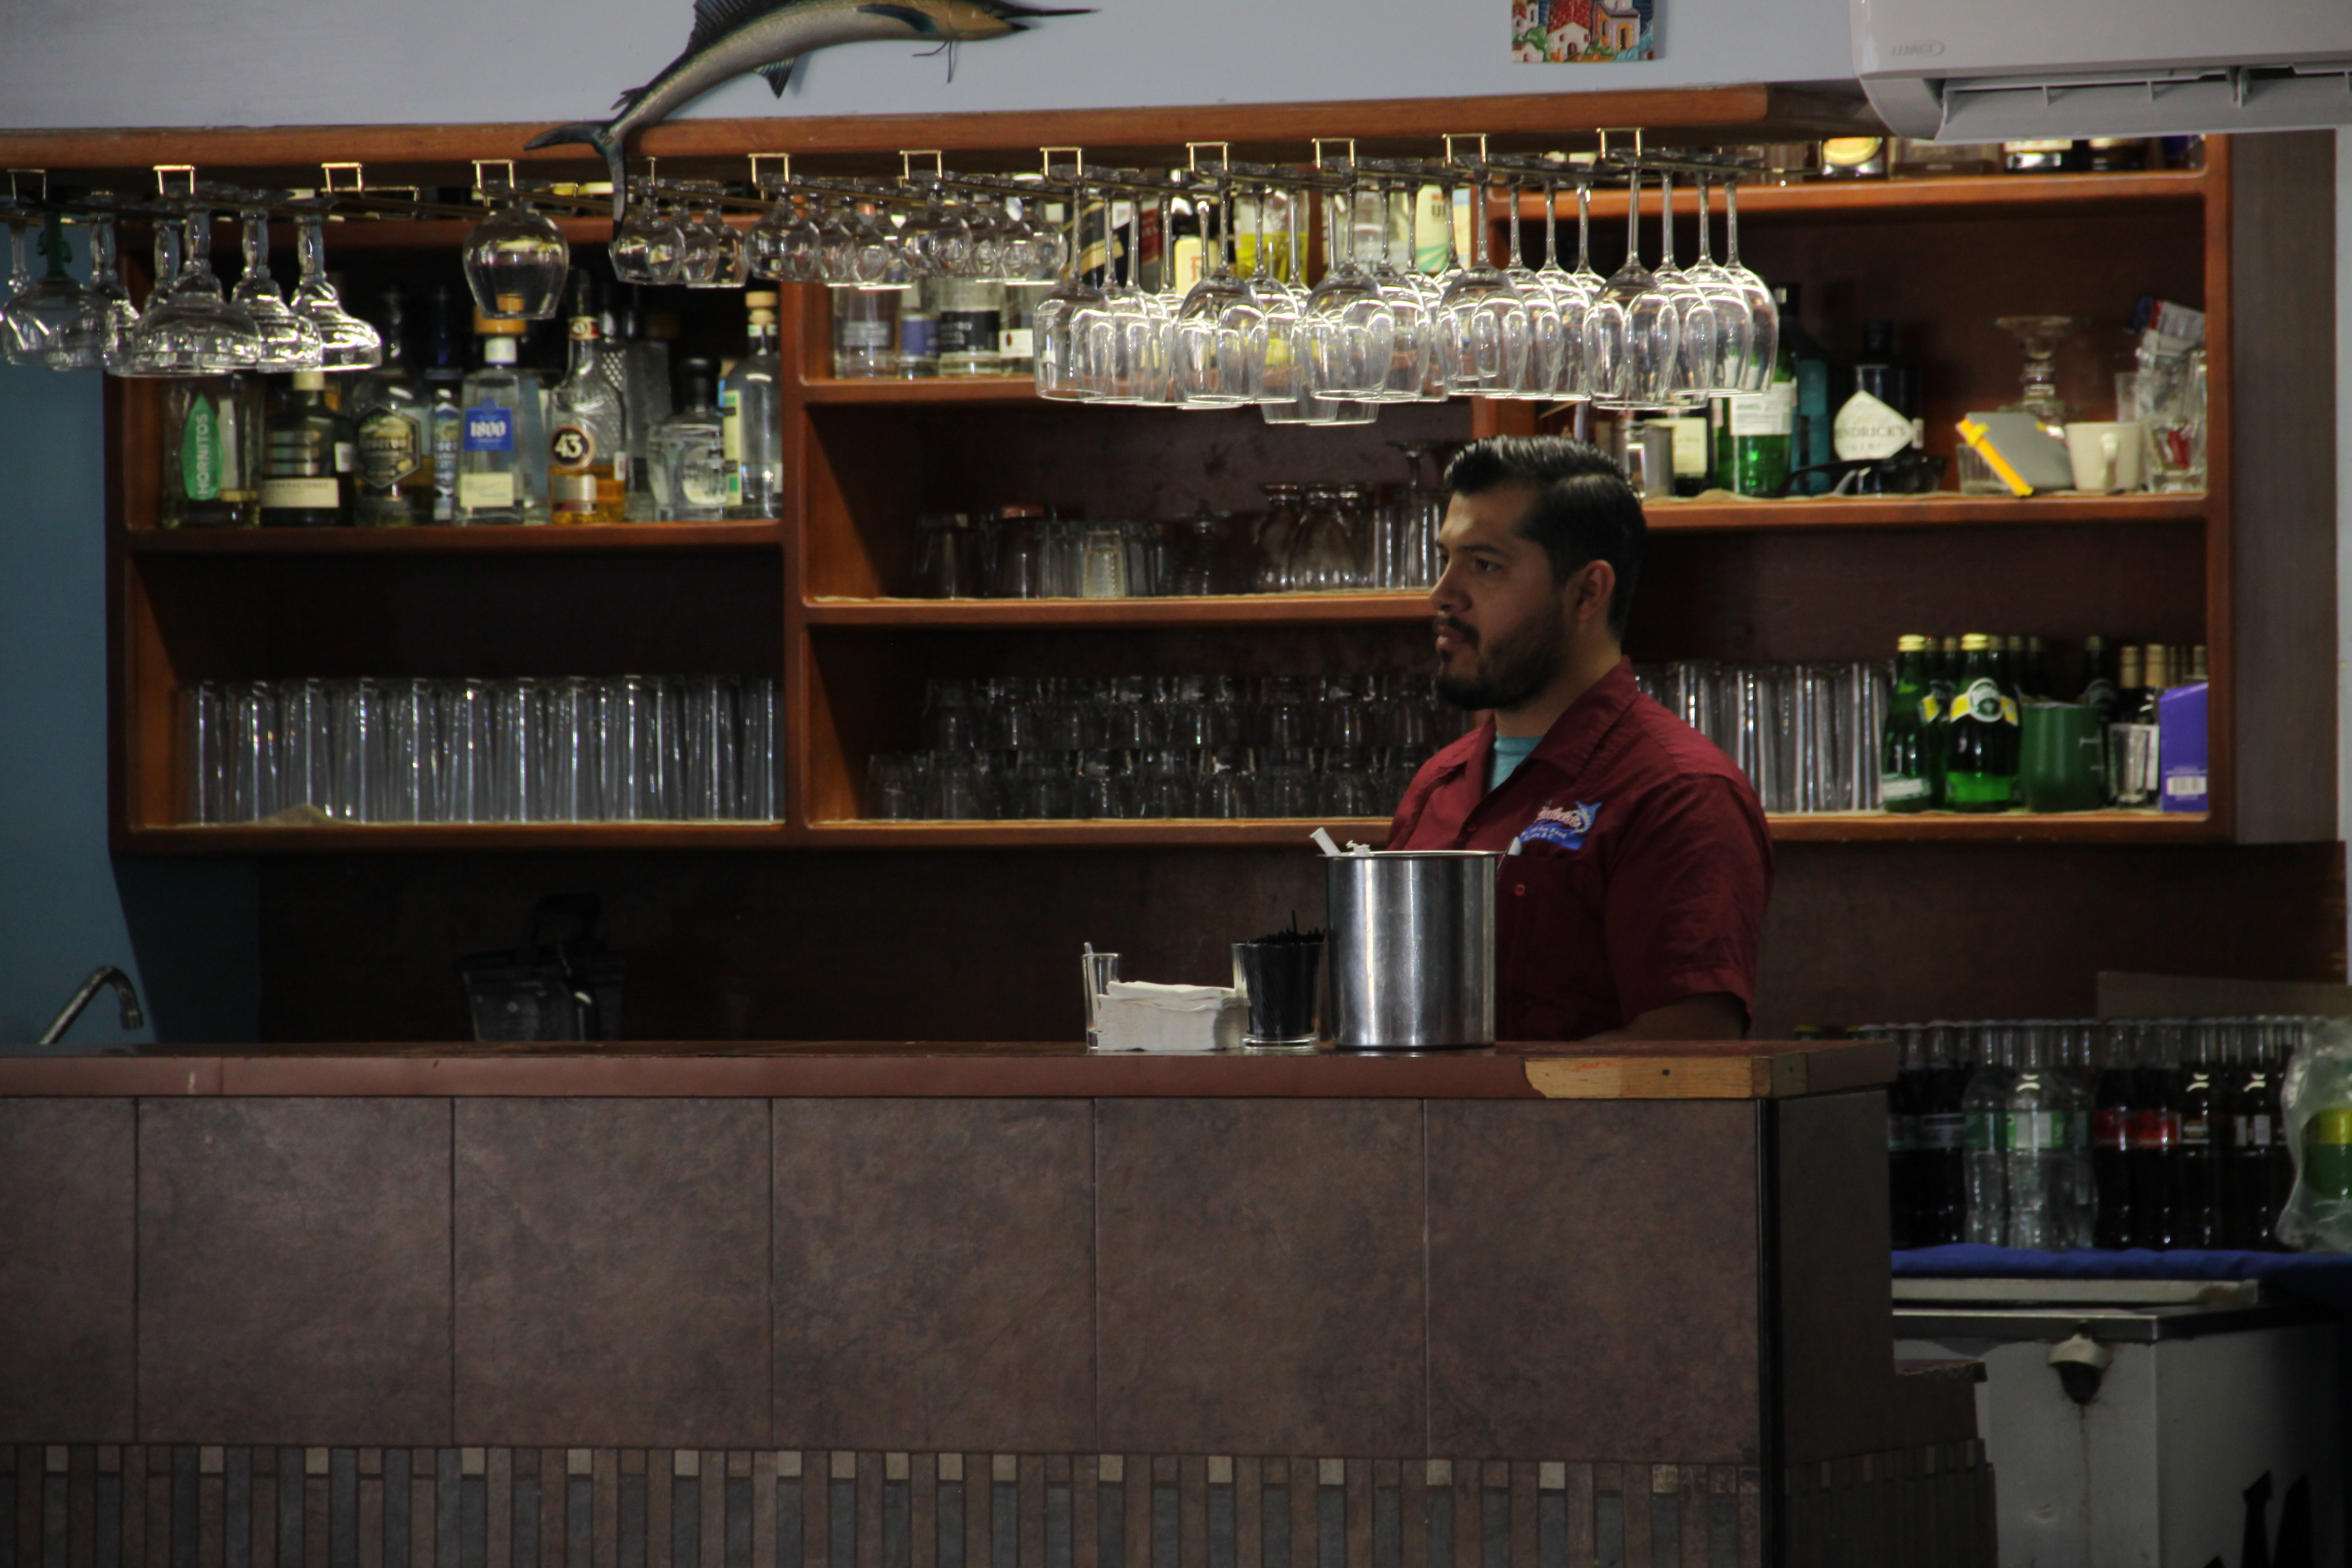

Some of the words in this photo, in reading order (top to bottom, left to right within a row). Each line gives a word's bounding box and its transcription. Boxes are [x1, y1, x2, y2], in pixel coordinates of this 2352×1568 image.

[470, 420, 507, 438] 1800
[1834, 426, 1907, 439] ENDRICK'S
[196, 413, 210, 494] HORNITOS
[554, 434, 583, 458] 43
